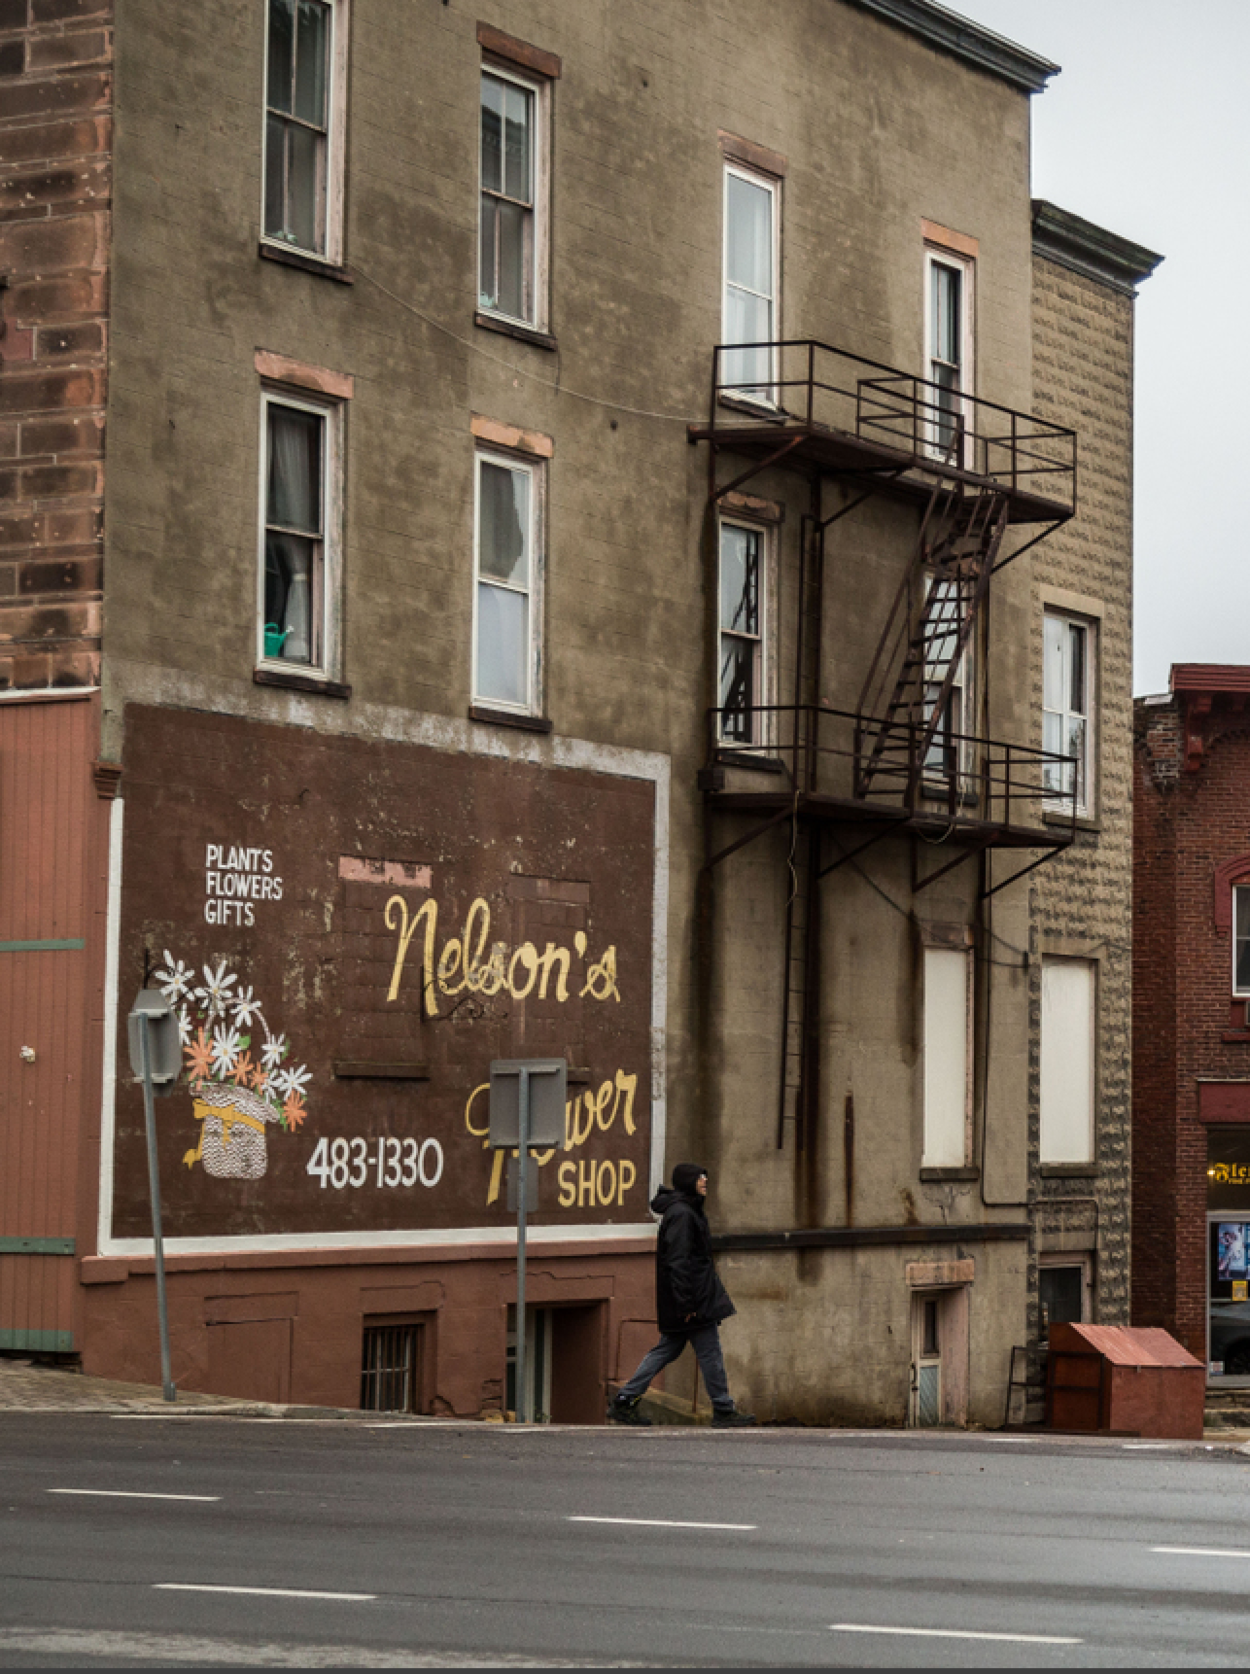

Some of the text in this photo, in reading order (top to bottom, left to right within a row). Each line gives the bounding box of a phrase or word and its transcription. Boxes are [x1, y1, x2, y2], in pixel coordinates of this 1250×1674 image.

[205, 843, 273, 872] PLANTS
[205, 871, 283, 901] FLOWERS
[204, 898, 255, 927] GIFTS
[384, 894, 621, 1016] Nelson's
[306, 1137, 444, 1189] 483-1330
[557, 1158, 637, 1208] SHOP
